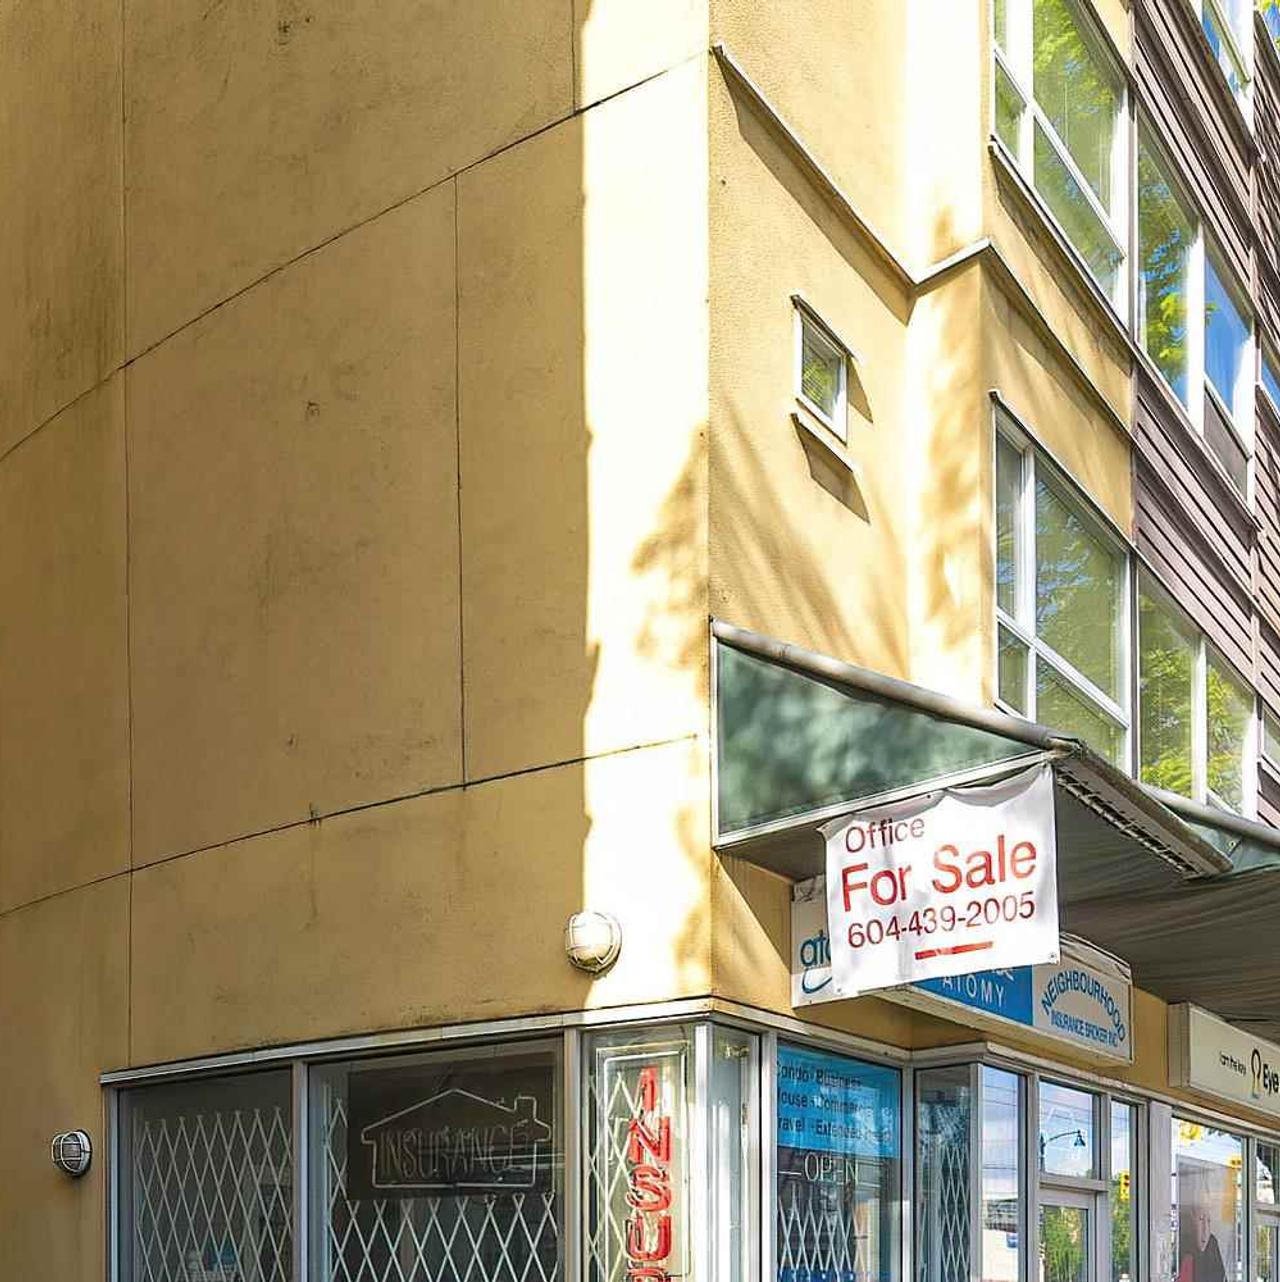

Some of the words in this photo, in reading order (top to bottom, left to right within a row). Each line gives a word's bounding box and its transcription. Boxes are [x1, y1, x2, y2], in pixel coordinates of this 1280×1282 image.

[845, 817, 925, 854] Office
[841, 862, 912, 912] For
[932, 834, 1037, 895] Sale
[847, 891, 1036, 949] 604-439-2005
[1040, 970, 1126, 1042] NEIGHBOURHOOD
[1263, 1063, 1279, 1096] Eye
[380, 1119, 530, 1181] INSURANCE
[804, 1151, 859, 1187] OPEN
